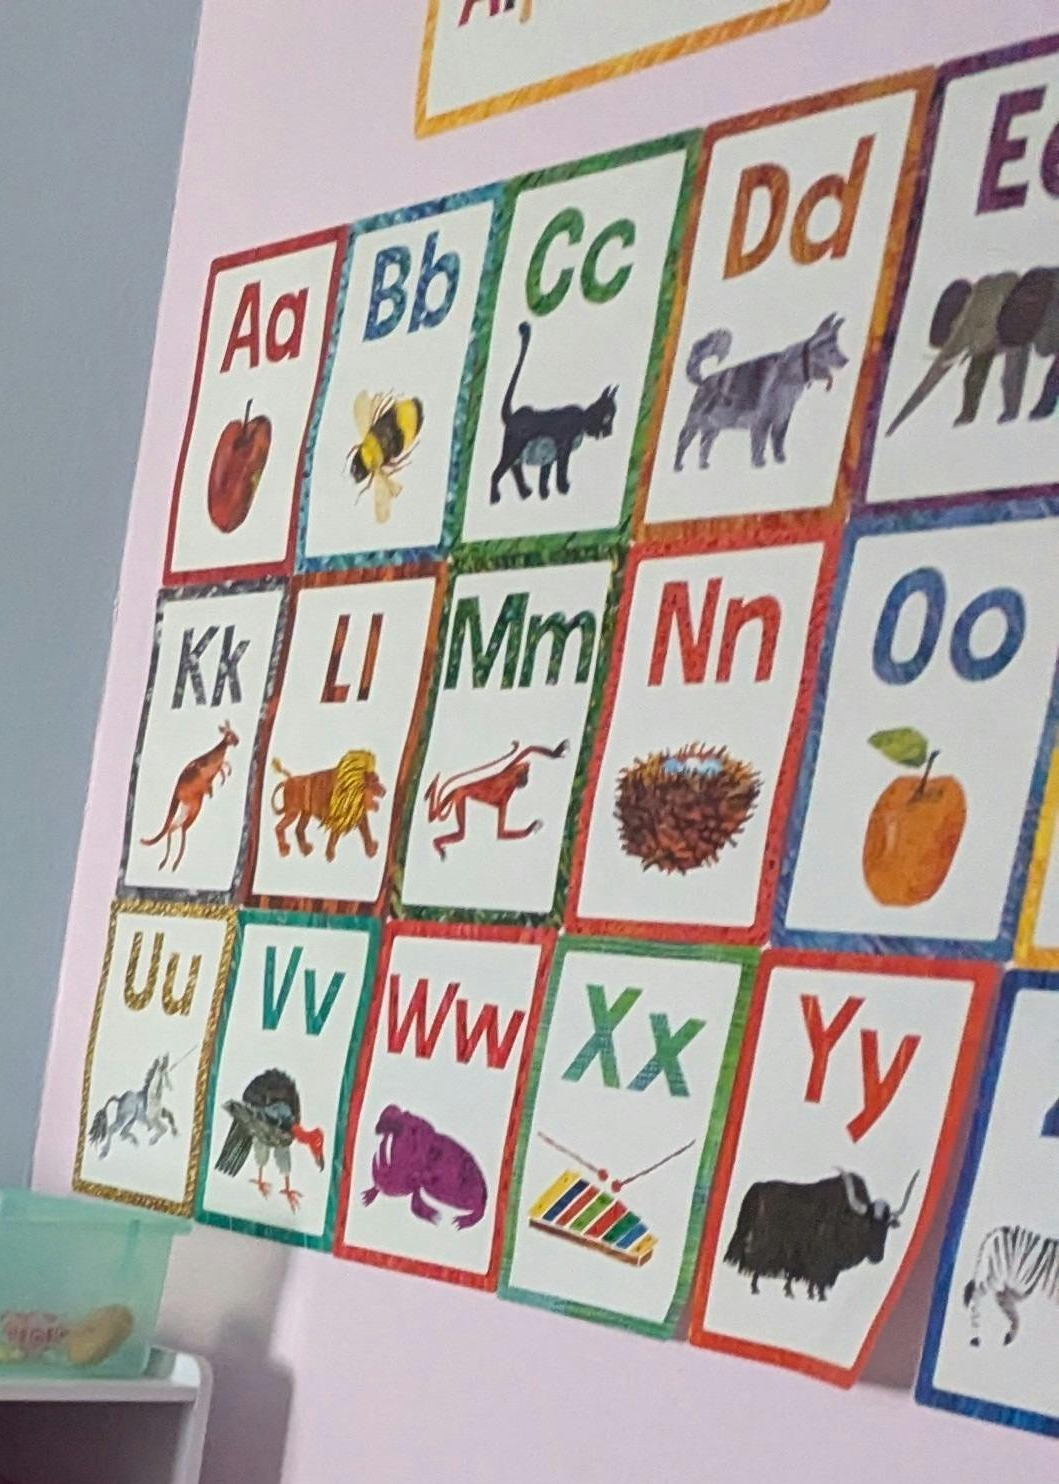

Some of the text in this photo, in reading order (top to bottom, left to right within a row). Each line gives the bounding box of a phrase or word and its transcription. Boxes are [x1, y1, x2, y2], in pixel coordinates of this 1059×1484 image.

[723, 134, 876, 280] Dd
[362, 230, 461, 342] Bb
[525, 207, 636, 317] Cc
[220, 280, 309, 374] Aa
[171, 625, 247, 709] Kk
[321, 613, 383, 704] Ll
[444, 593, 596, 690] Mm
[647, 579, 782, 687] Nn
[872, 566, 1026, 686] Oo
[124, 931, 202, 1016] Uu
[262, 947, 346, 1036] Vv
[386, 974, 526, 1070] Ww
[561, 984, 705, 1096] Xx
[800, 995, 921, 1143] Yy
